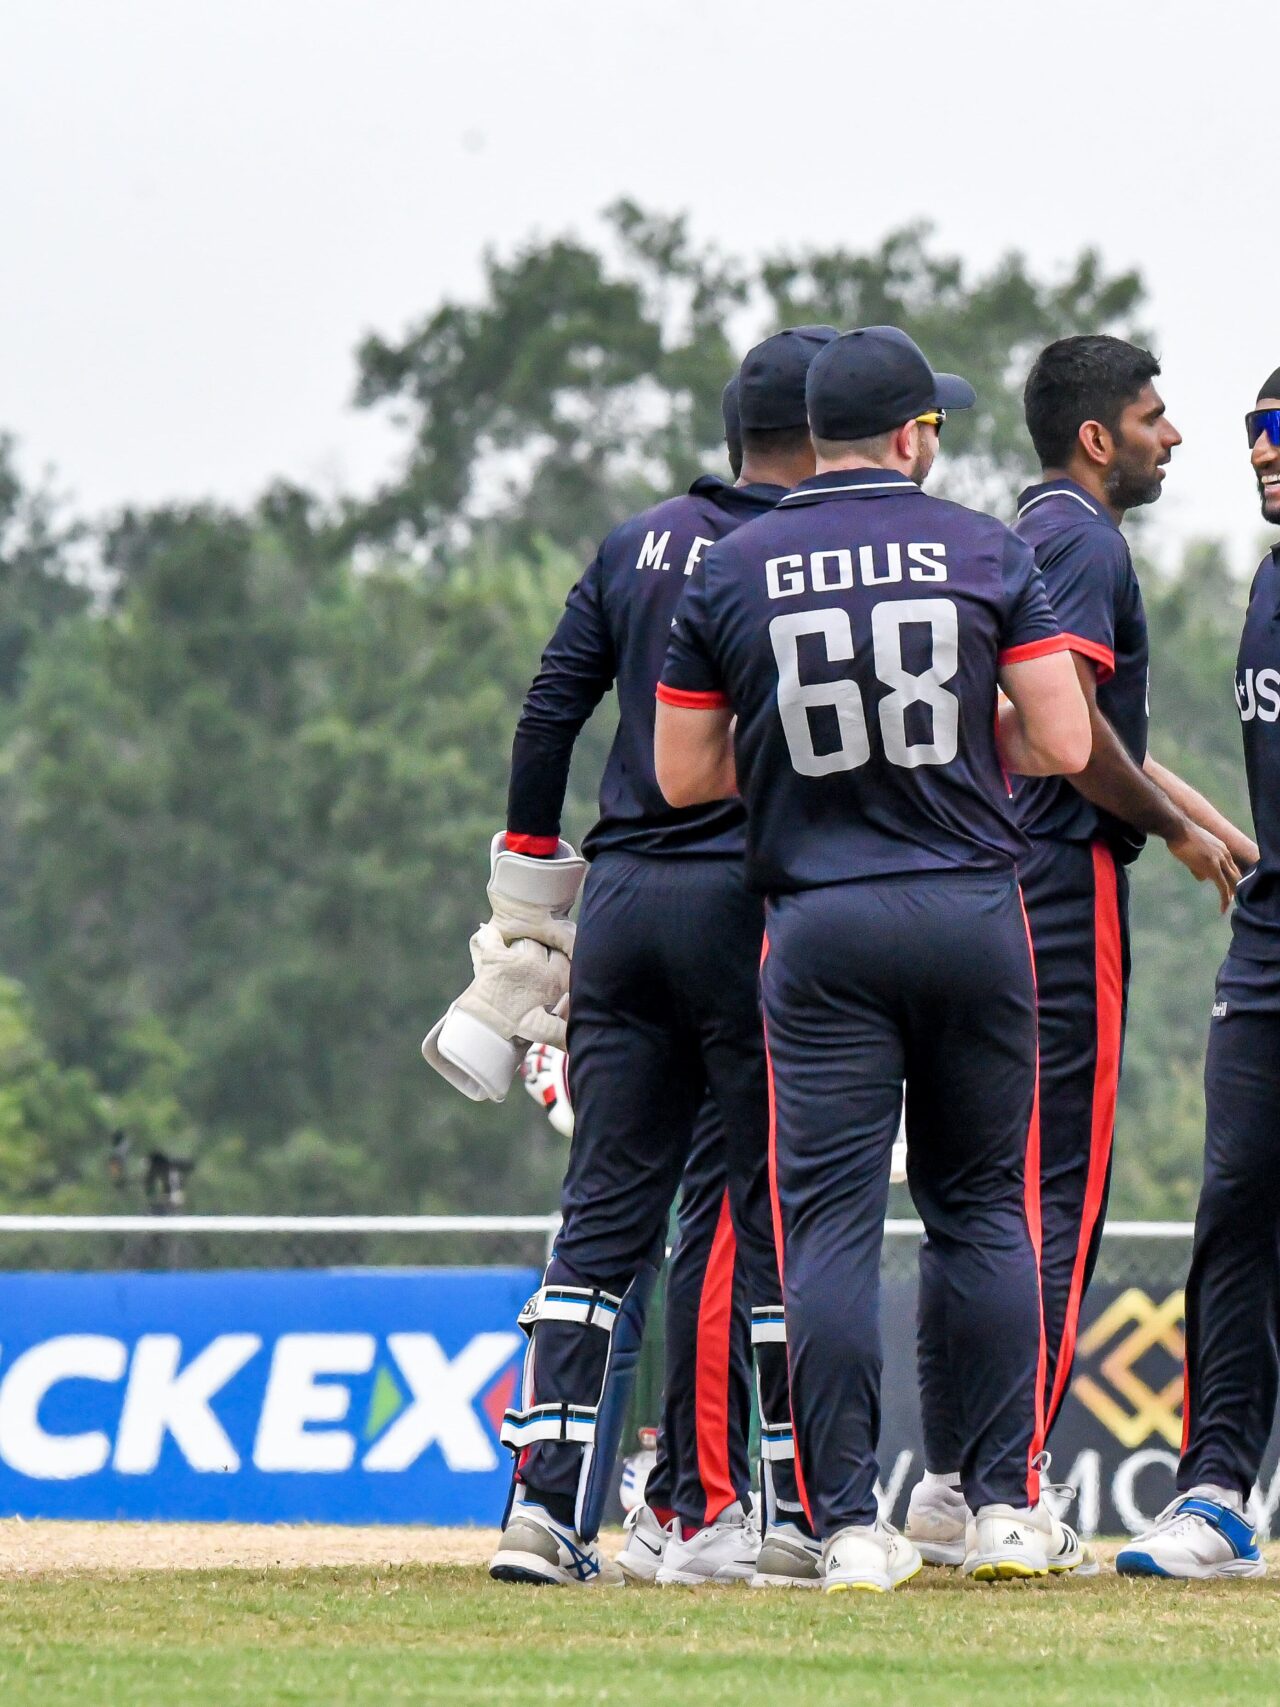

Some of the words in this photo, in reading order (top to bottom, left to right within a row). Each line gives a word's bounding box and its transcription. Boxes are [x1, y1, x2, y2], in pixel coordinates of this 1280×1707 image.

[636, 530, 671, 571] M.
[765, 543, 948, 599] GOUS
[769, 598, 959, 777] 68
[0, 1333, 523, 1480] CKEX
